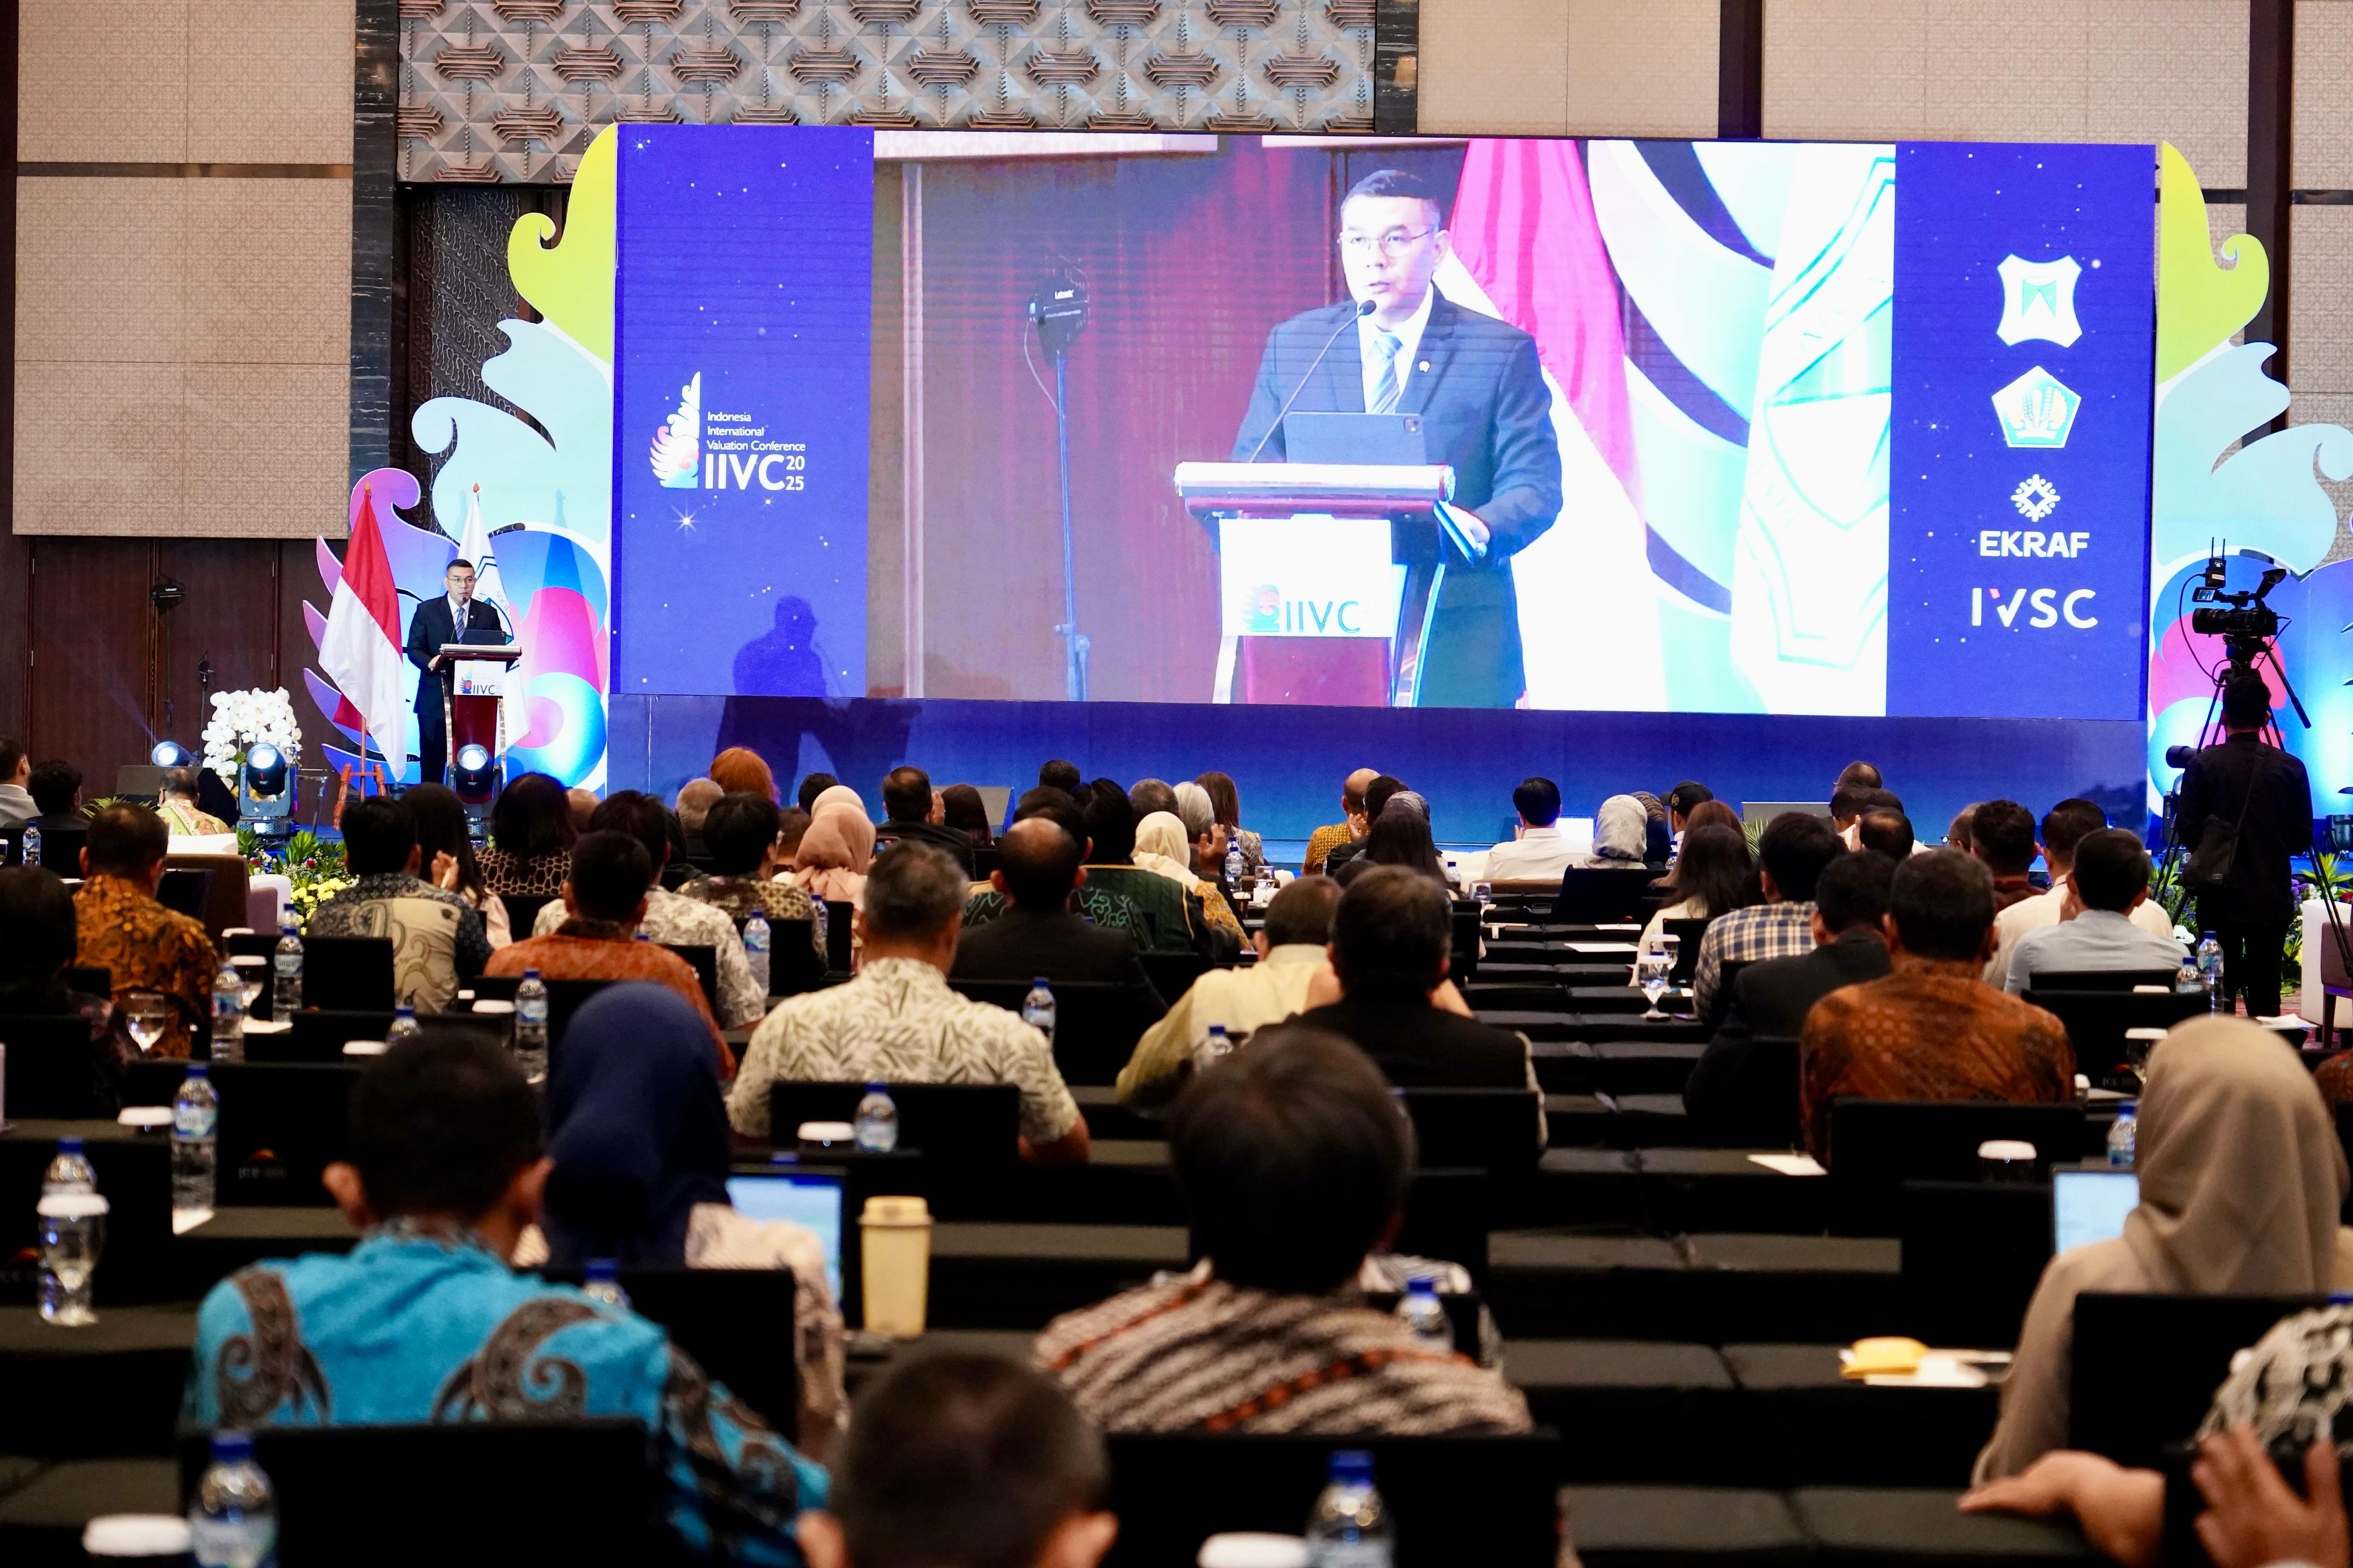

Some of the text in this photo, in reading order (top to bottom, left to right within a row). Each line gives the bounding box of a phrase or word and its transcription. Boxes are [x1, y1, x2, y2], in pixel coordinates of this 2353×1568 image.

[707, 411, 752, 422] Indonesia
[707, 425, 765, 437] International
[706, 439, 806, 452] Valuation Conference
[705, 453, 805, 491] IIVC 20
[785, 475, 805, 491] 25
[1980, 530, 2090, 558] EKRAF
[1971, 588, 2098, 629] IVSC
[1285, 601, 1360, 634] IIVC
[473, 684, 495, 695] IIVC
